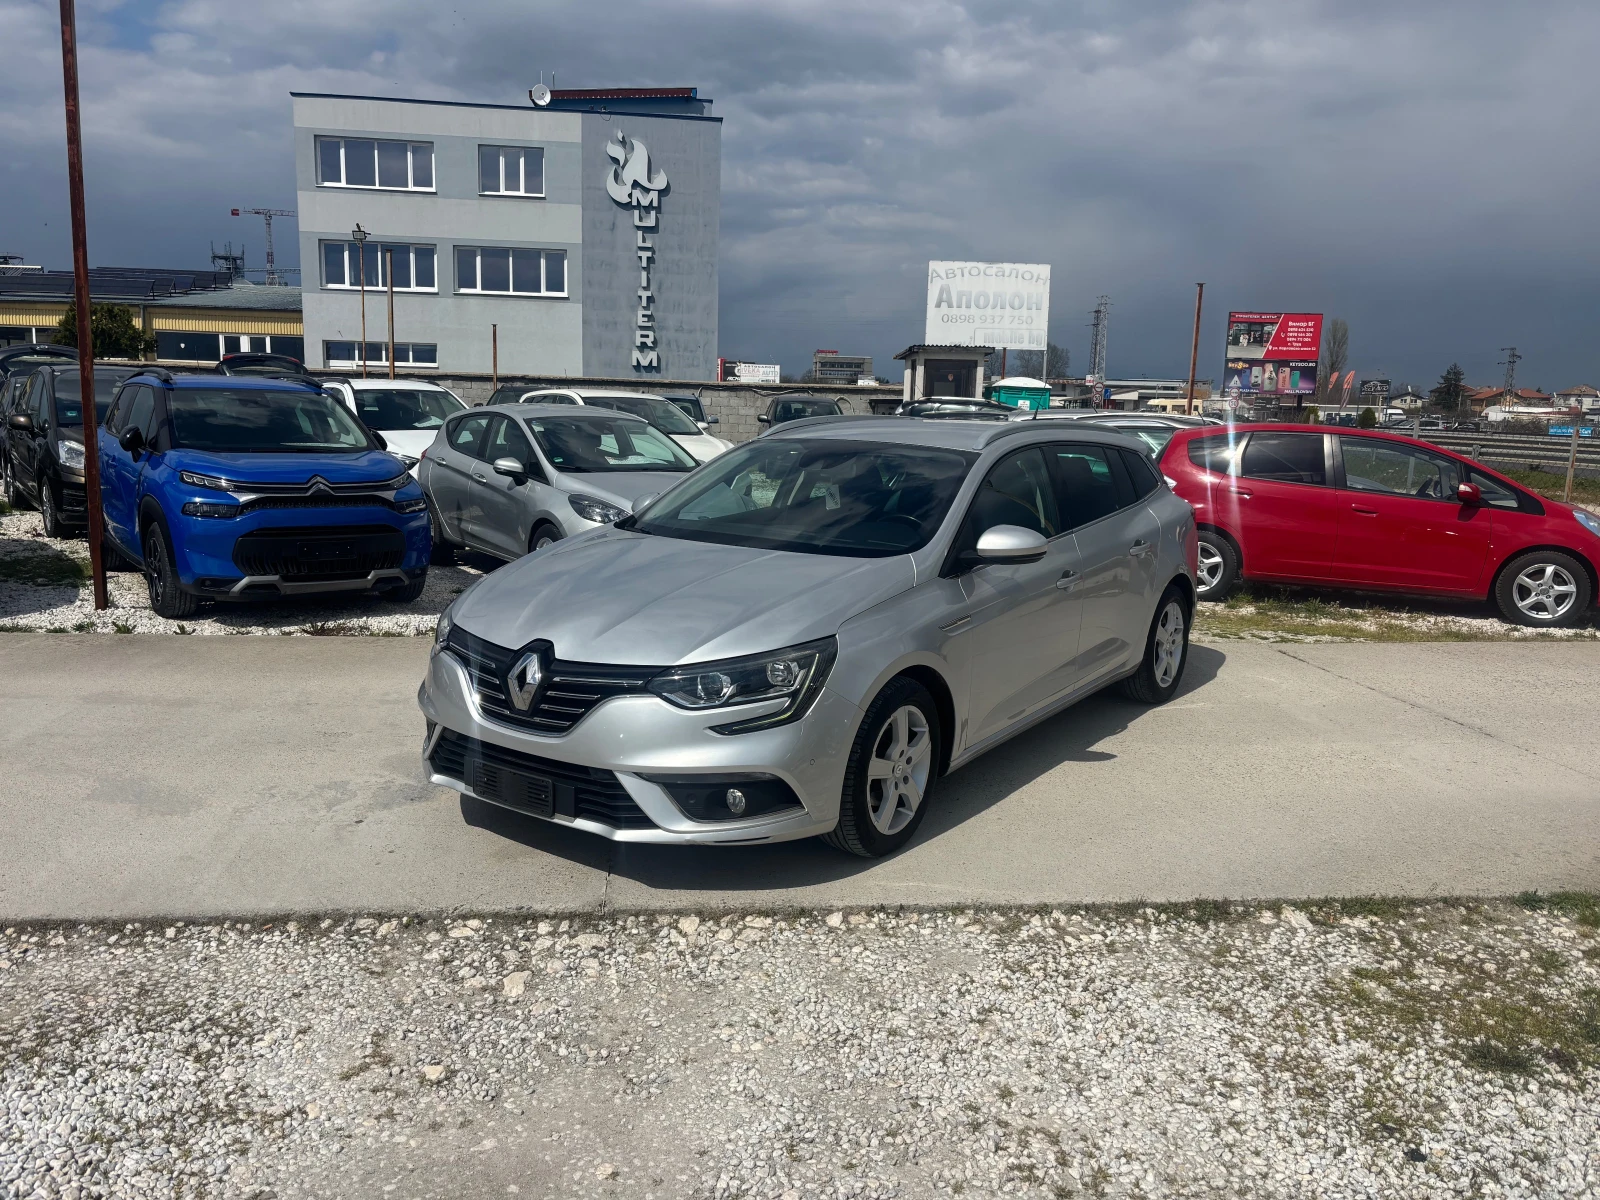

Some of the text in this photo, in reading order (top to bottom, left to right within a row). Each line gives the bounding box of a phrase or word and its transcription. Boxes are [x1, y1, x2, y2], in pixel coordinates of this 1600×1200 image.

[632, 190, 658, 367] MULTITERM
[934, 284, 1043, 310] Аполон
[942, 314, 1033, 325] 0898 937 750
